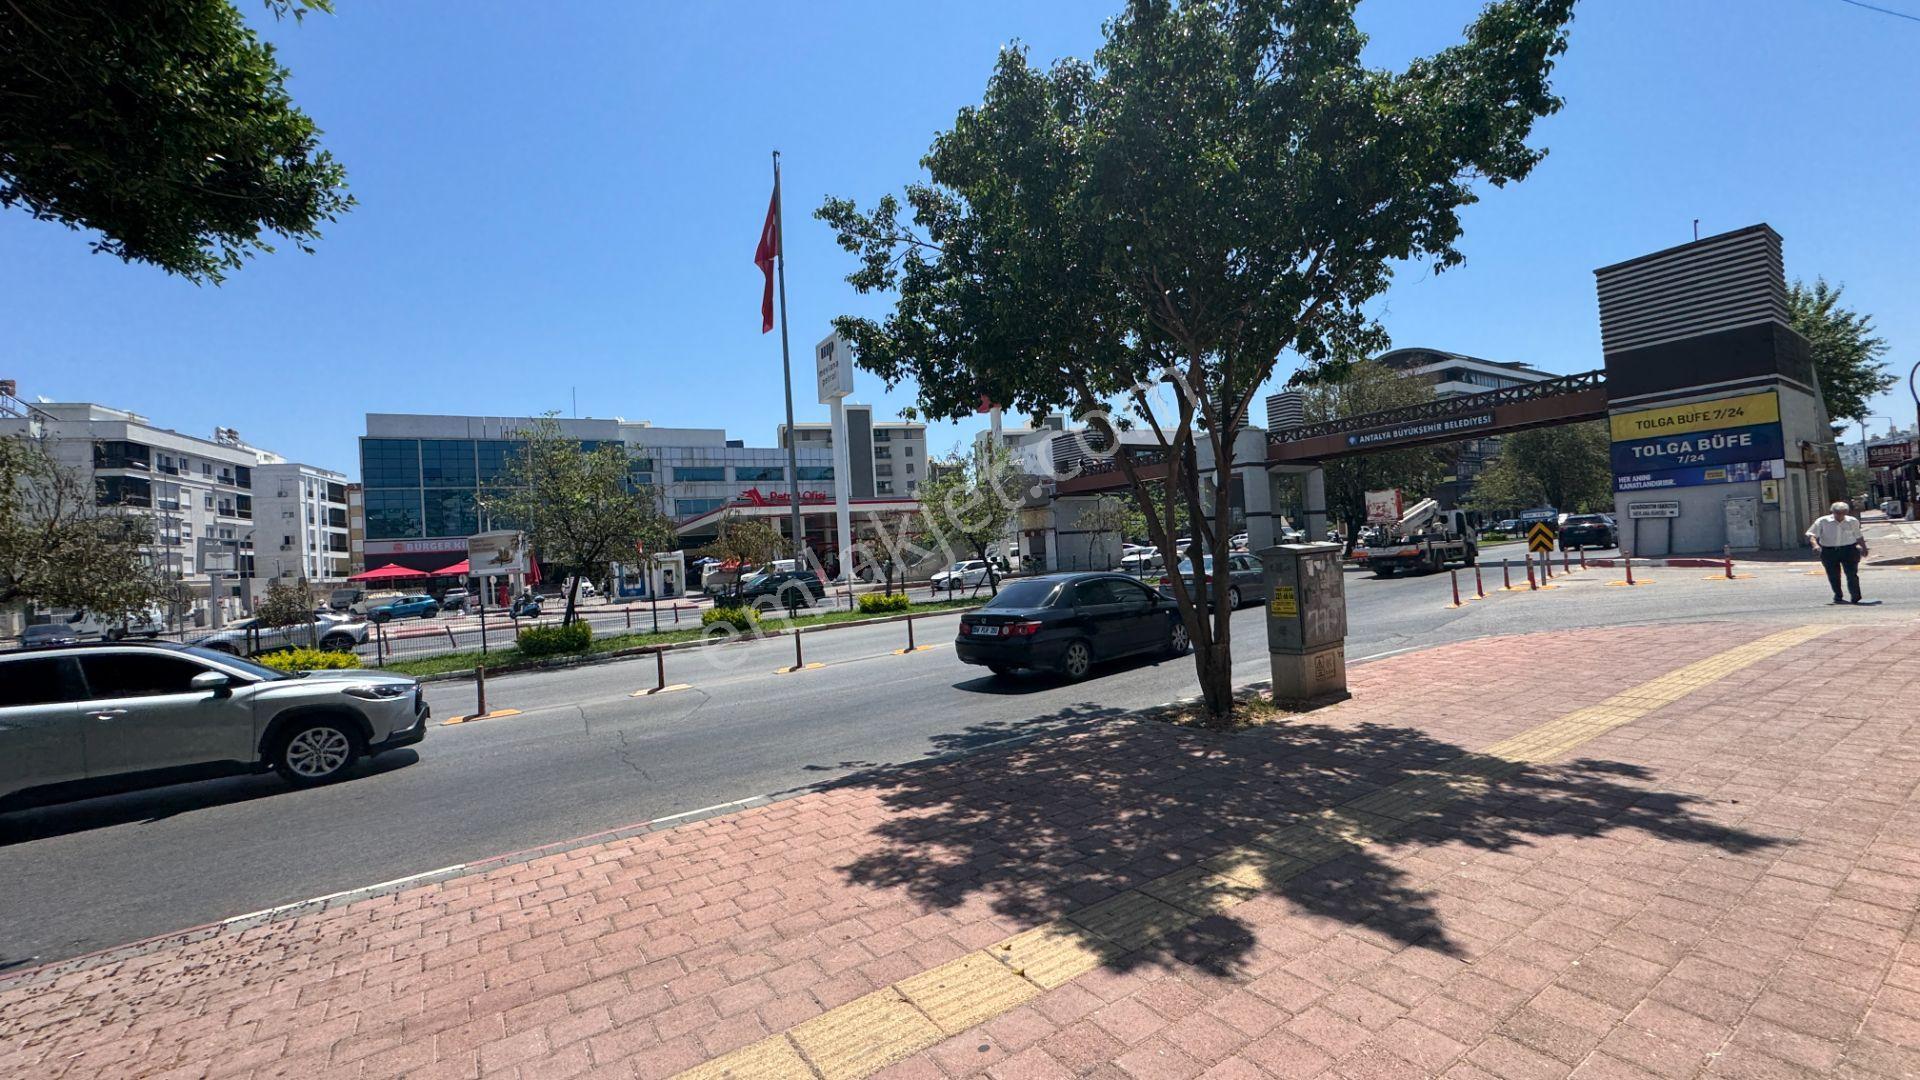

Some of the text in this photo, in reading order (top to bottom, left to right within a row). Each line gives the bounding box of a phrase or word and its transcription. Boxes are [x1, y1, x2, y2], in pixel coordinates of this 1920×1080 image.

[1636, 417, 1675, 430] TOLGA
[1713, 407, 1745, 420] 7/24
[1360, 415, 1491, 443] ANTALYA BÜYÜKŞEHİR BELEDİYESİ
[1631, 433, 1752, 458] TOLGA BÜFE
[1676, 454, 1705, 464] 7/24
[769, 490, 827, 500] Petrl Ofisi
[406, 542, 450, 552] BURGER
